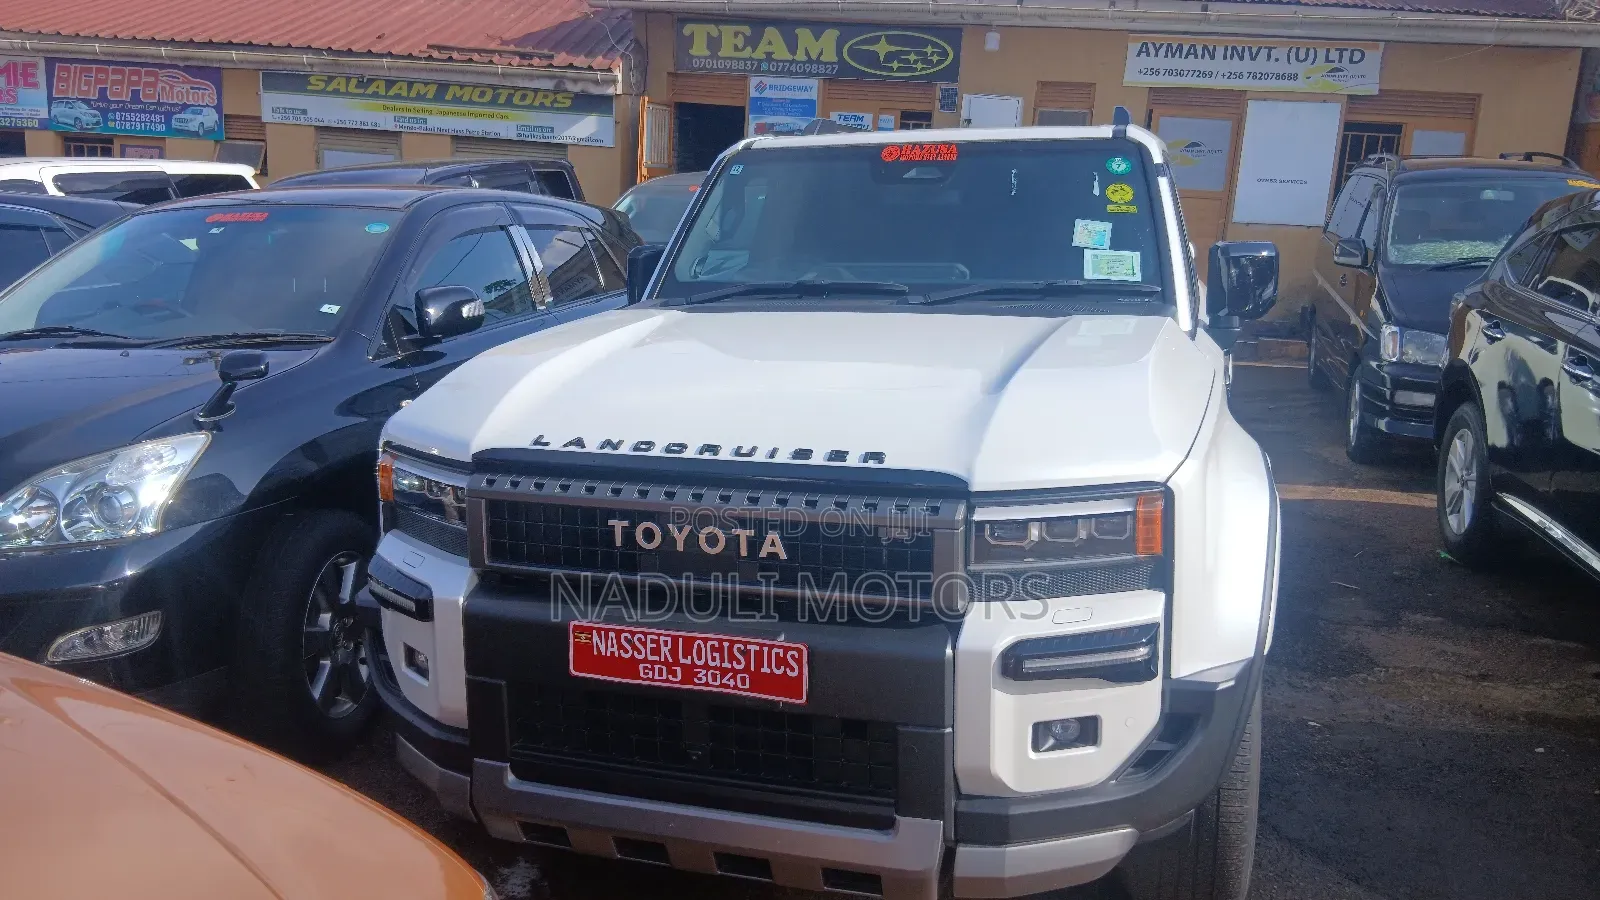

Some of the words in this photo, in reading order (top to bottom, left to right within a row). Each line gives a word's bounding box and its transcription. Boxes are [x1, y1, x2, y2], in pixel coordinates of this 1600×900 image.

[682, 23, 840, 64] TEAM
[1135, 41, 1217, 60] AYMAN
[1222, 44, 1280, 64] INVT.
[1286, 46, 1318, 66] (U)
[1324, 48, 1366, 65] LTD
[692, 58, 758, 72] 0701098837
[769, 61, 839, 75] 0774098827
[1137, 68, 1161, 78] +256
[1162, 68, 1214, 80] 703077269
[1220, 70, 1244, 80] +256
[1246, 70, 1299, 82] 782078688
[160, 84, 218, 106] Motors
[306, 75, 438, 99] SALAAM
[444, 84, 575, 108] MOTORS
[768, 84, 814, 93] BRIDGEWAY
[838, 113, 864, 122] TEAM
[532, 434, 887, 465] LANDCRUISER
[607, 518, 788, 560] TOYOTA
[592, 629, 673, 663] NASSER
[678, 640, 800, 678] LOGISTICS
[638, 662, 682, 682] GDJ
[694, 668, 750, 690] 3040
